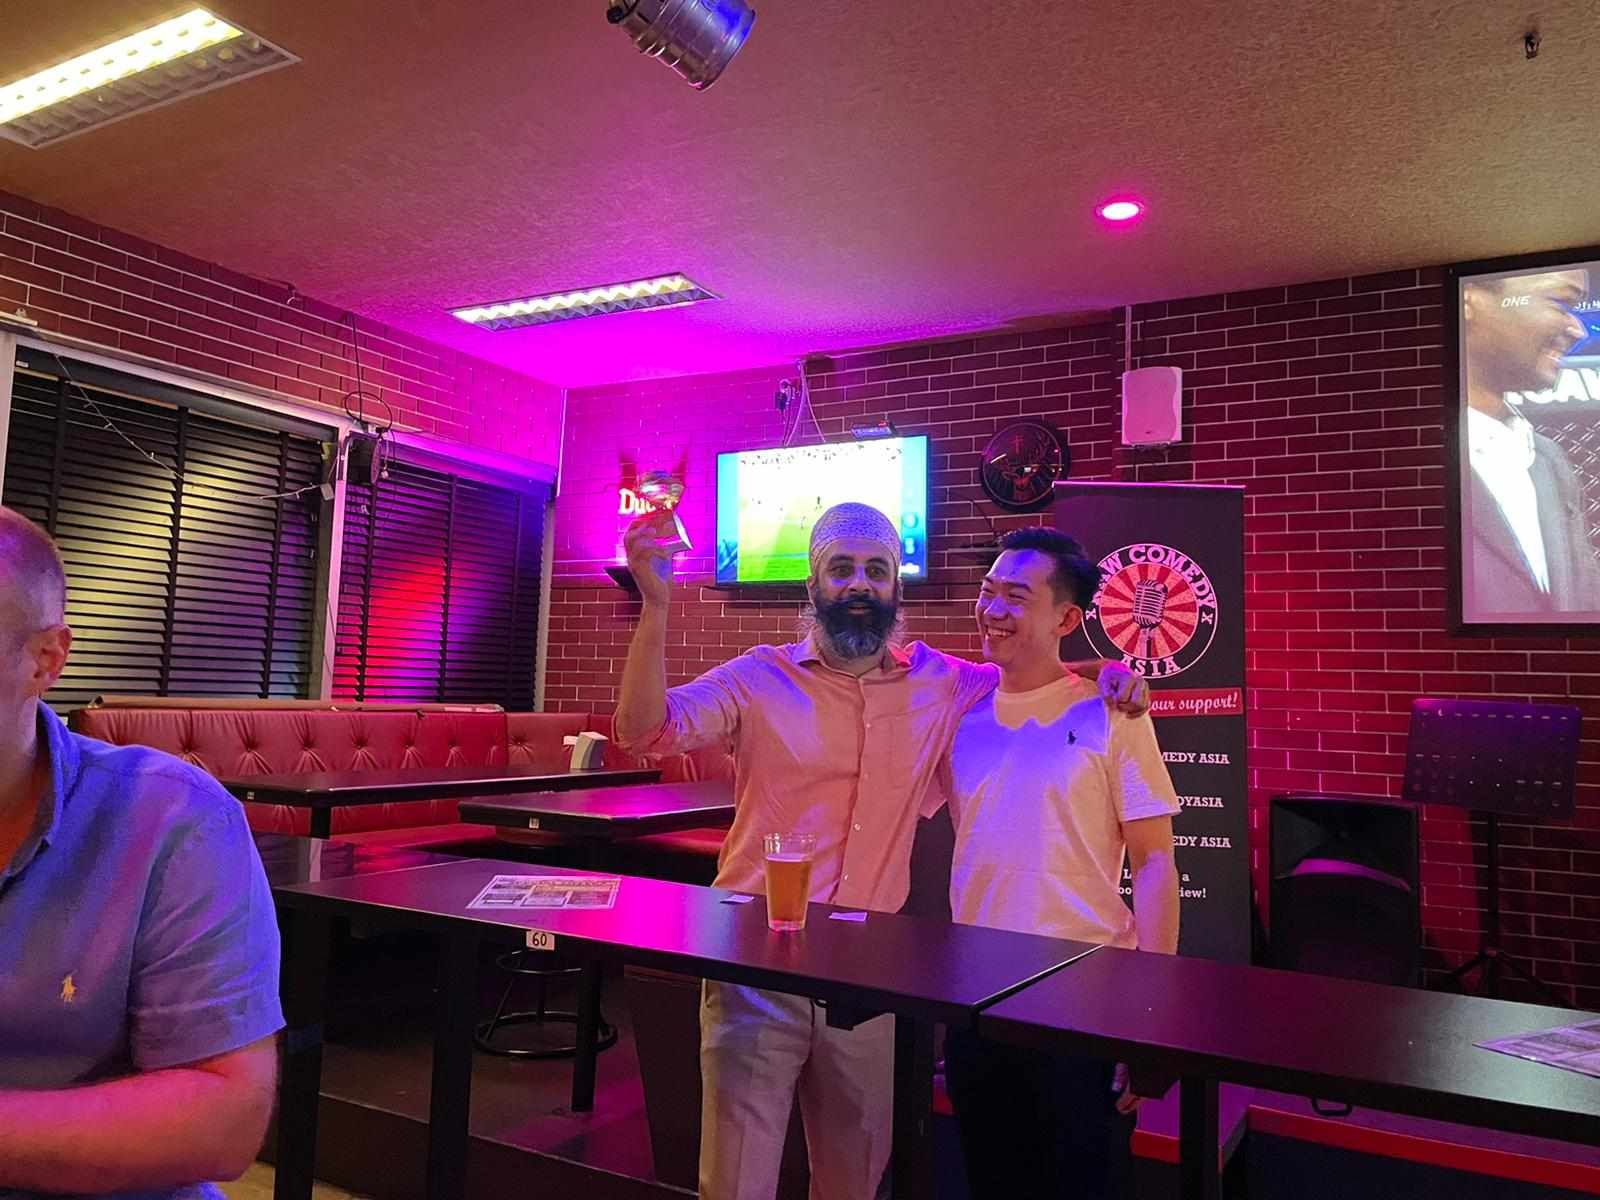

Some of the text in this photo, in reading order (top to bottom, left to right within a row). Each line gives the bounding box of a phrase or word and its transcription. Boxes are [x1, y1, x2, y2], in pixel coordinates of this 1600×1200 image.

[1128, 545, 1217, 609] COMEDY
[1121, 653, 1181, 677] ASIA
[1151, 691, 1238, 714] our support!
[1161, 751, 1231, 765] MEDY ASIA
[1176, 795, 1225, 808] DYASIA
[1172, 835, 1232, 849] EDY ASIA
[1180, 887, 1207, 898] iew!
[532, 932, 548, 947] 60
